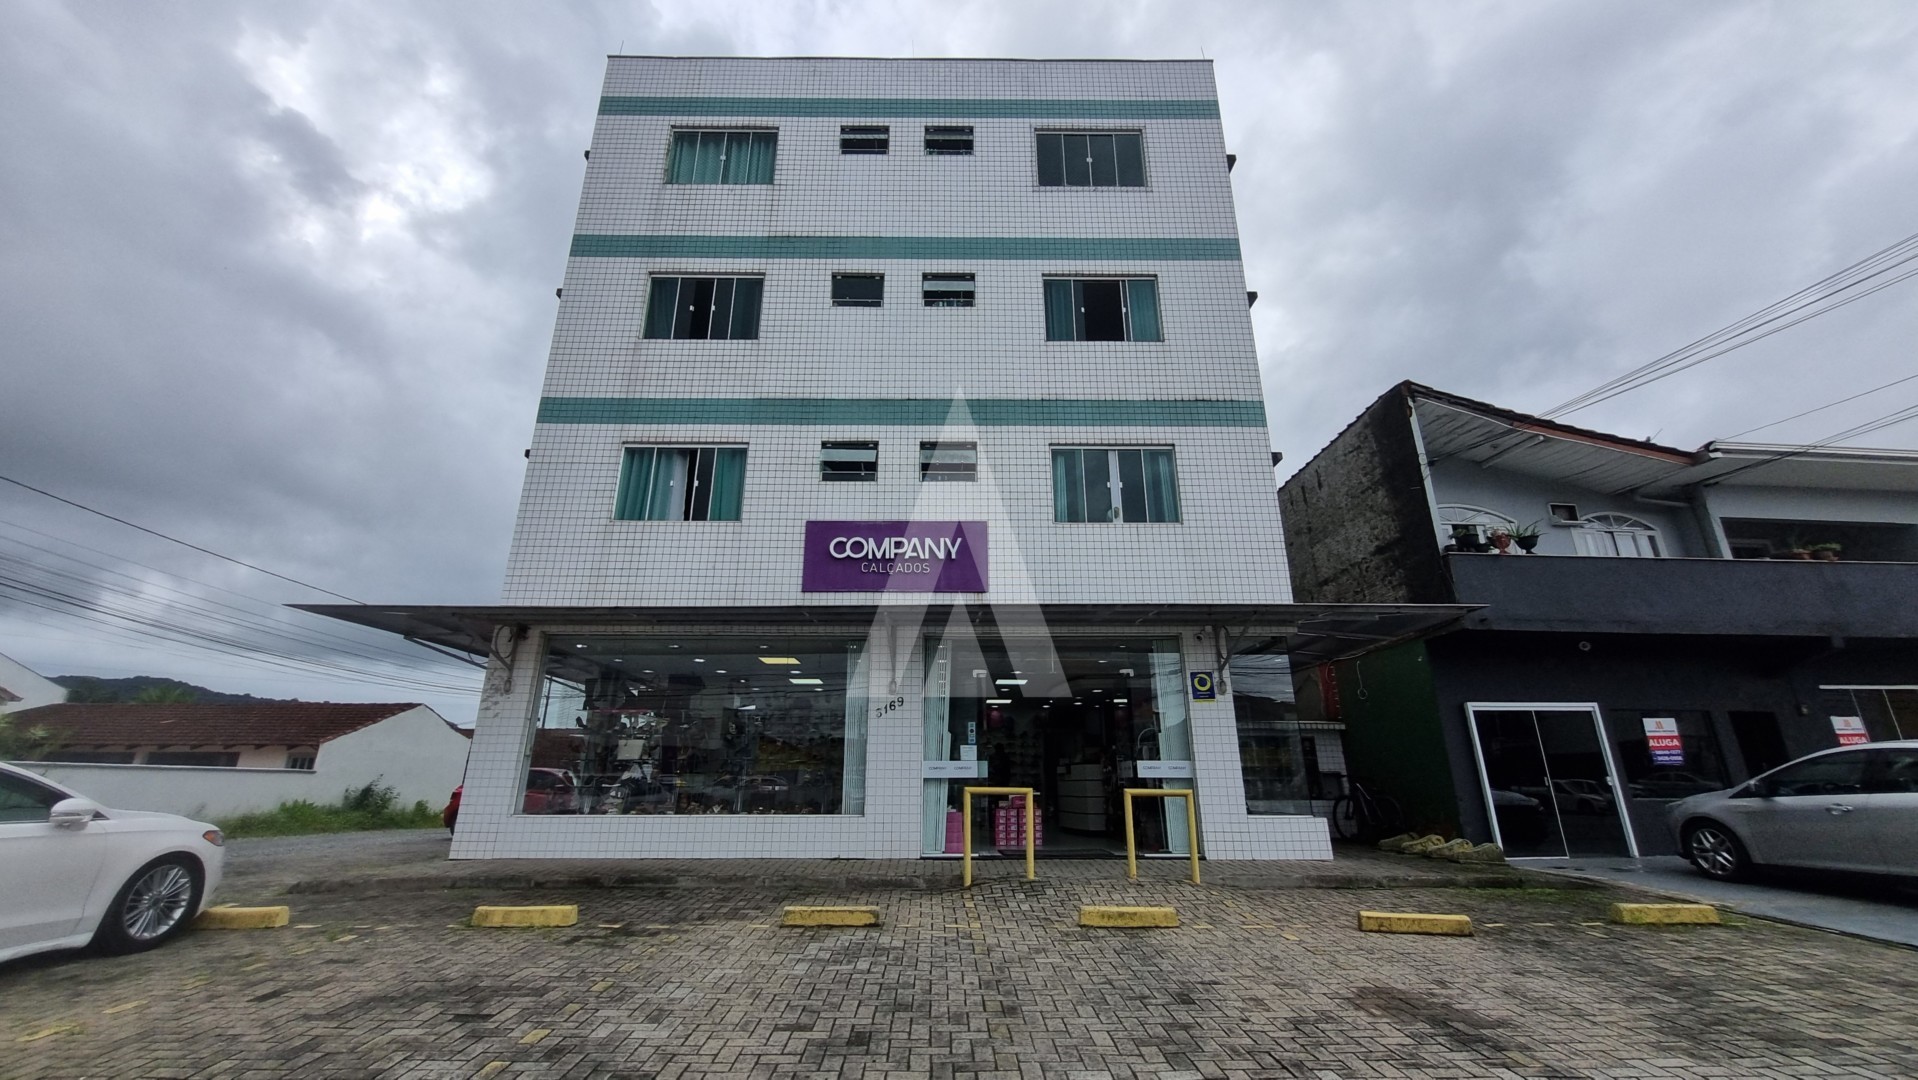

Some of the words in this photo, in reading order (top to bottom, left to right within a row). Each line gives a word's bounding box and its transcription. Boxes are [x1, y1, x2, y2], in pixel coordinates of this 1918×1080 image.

[829, 536, 962, 560] COMPANY
[861, 562, 931, 574] CALÇADOS
[1649, 738, 1680, 747] ALUGA
[1840, 735, 1868, 744] ALUGA
